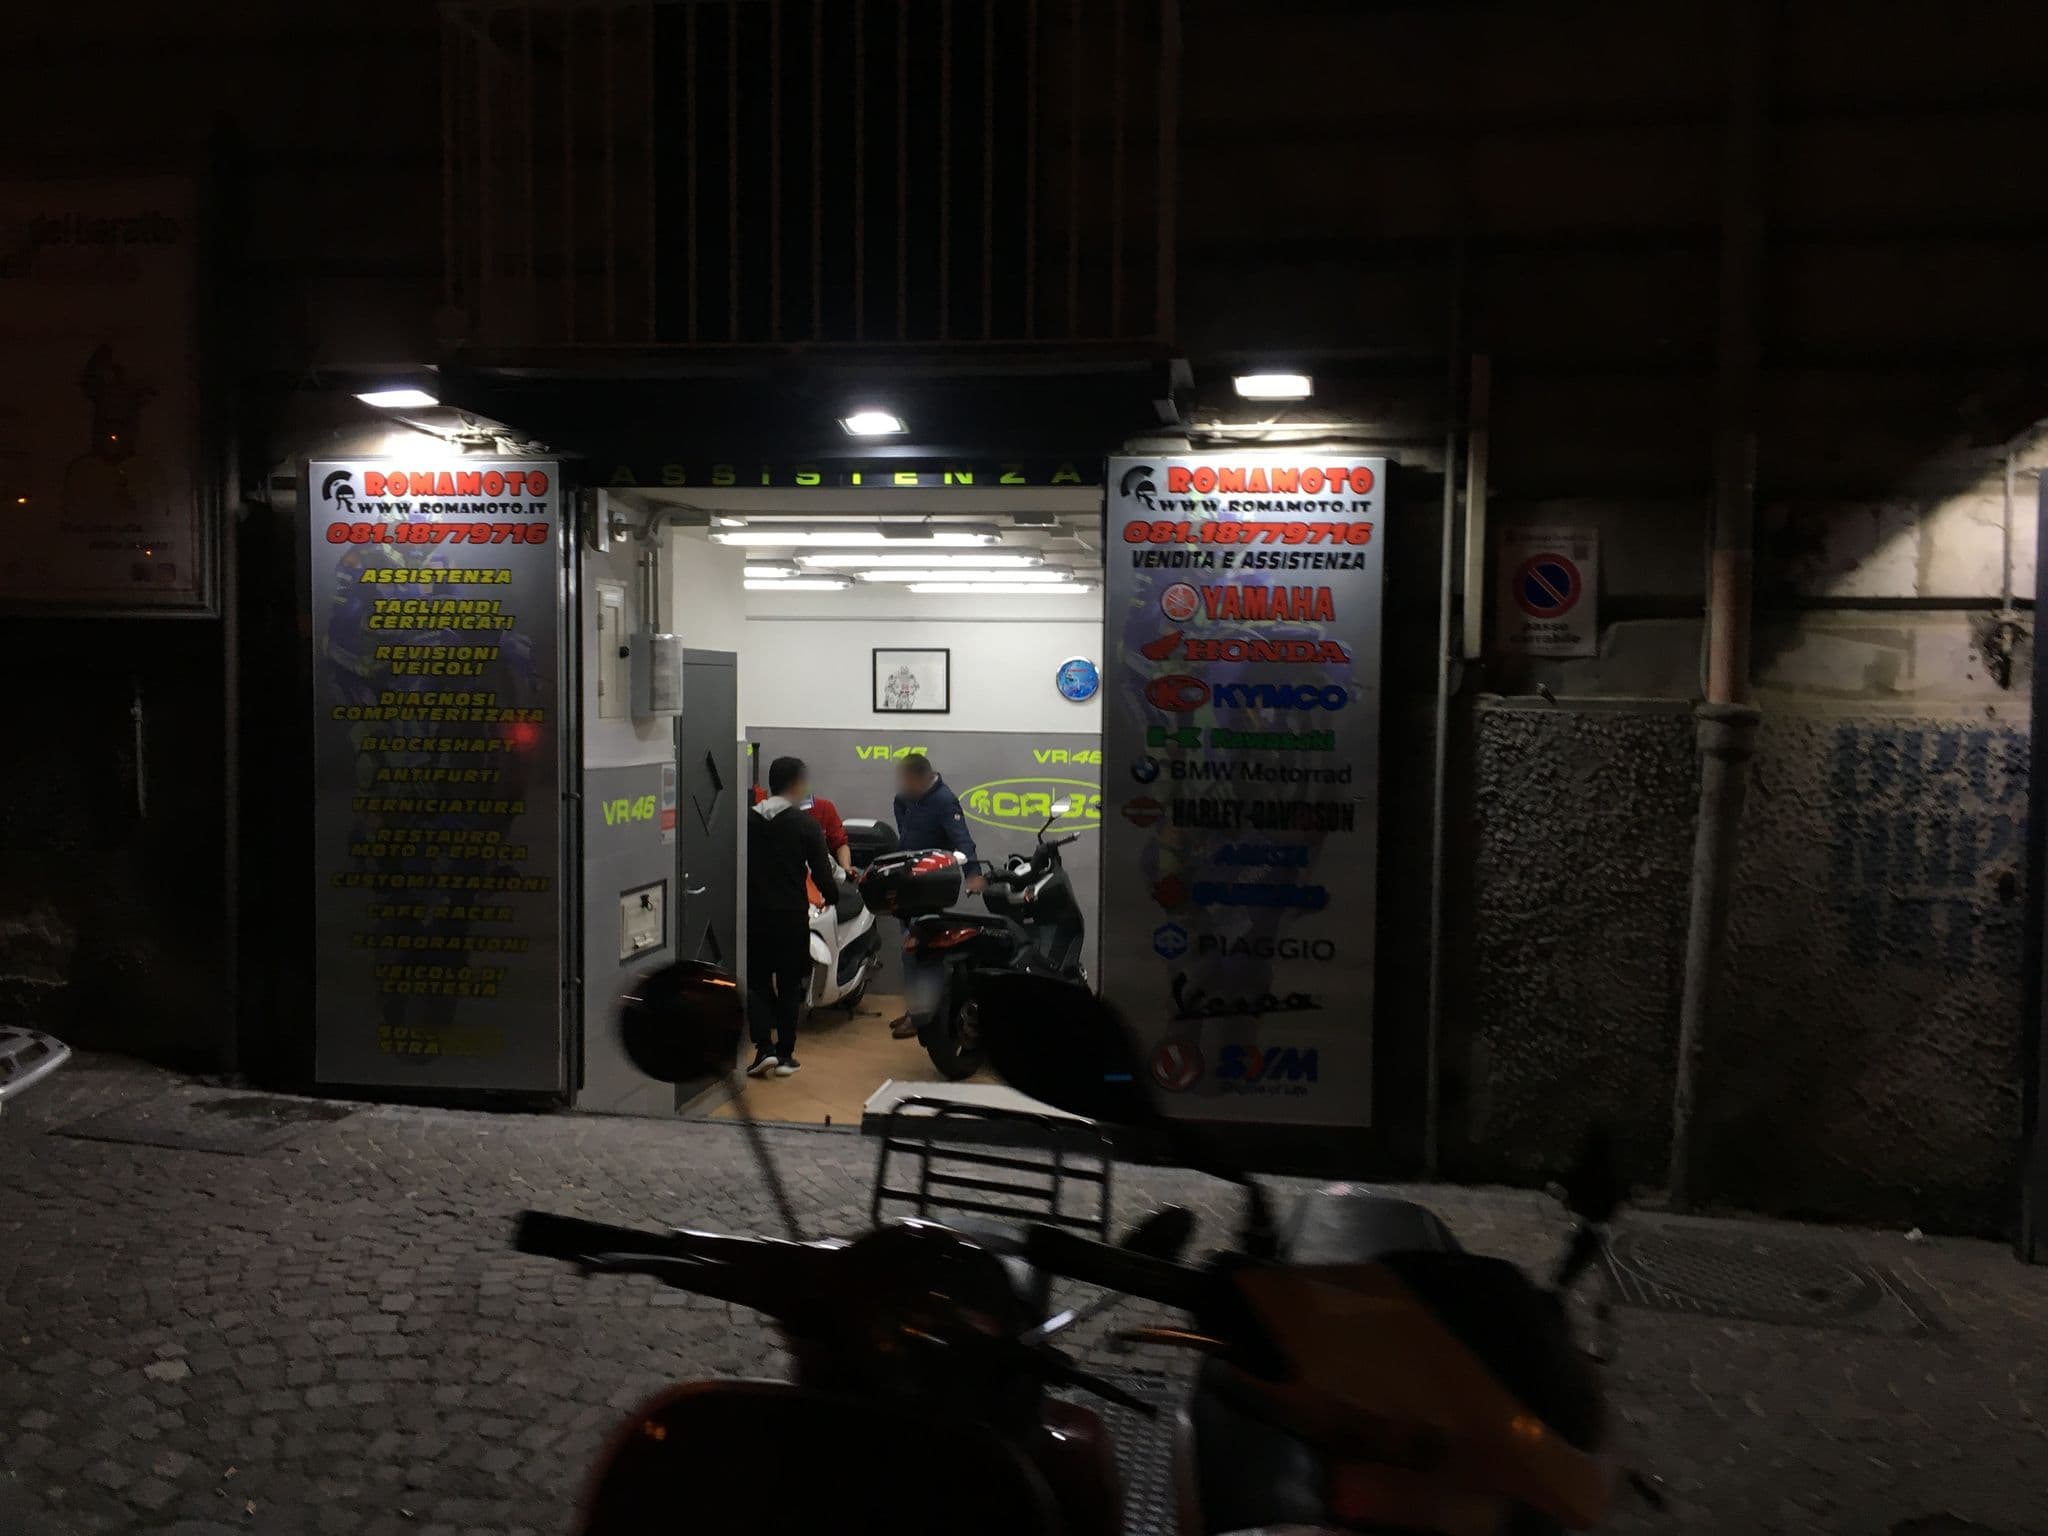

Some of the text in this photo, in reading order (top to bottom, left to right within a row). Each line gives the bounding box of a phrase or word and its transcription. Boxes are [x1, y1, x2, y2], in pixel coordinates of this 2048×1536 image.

[363, 471, 549, 497] ROMAMOTO
[1167, 466, 1375, 495] ROMAMOTO
[357, 502, 547, 514] WWW.ROMAMOTO.IT
[1158, 500, 1372, 513] WWW.ROMAMOTO.IT
[326, 522, 549, 544] 081.18779716
[1123, 520, 1374, 545] 081.18779716
[1132, 551, 1366, 570] VENDITA E ASSISTENZA
[360, 569, 512, 584] ASSISTENZA
[373, 600, 501, 615] TAGLIANDI
[1201, 585, 1336, 622] YAMAHA
[368, 615, 515, 630] CERTIFICATI
[375, 646, 499, 661] REVISIONI
[1183, 638, 1351, 664] HONDA
[390, 661, 485, 676] VEICOLI
[380, 691, 497, 706] DIAGNOSI
[1212, 683, 1349, 711] KYMCO
[330, 706, 546, 722] COMPUTERIZZATA
[375, 767, 501, 783] ANTIFURTI
[1170, 760, 1353, 784] BMW Motorrad
[1172, 797, 1355, 832] HARLEY-DAVIDSON
[1197, 935, 1336, 961] PIAGGIO
[1215, 1044, 1319, 1083] SYM
